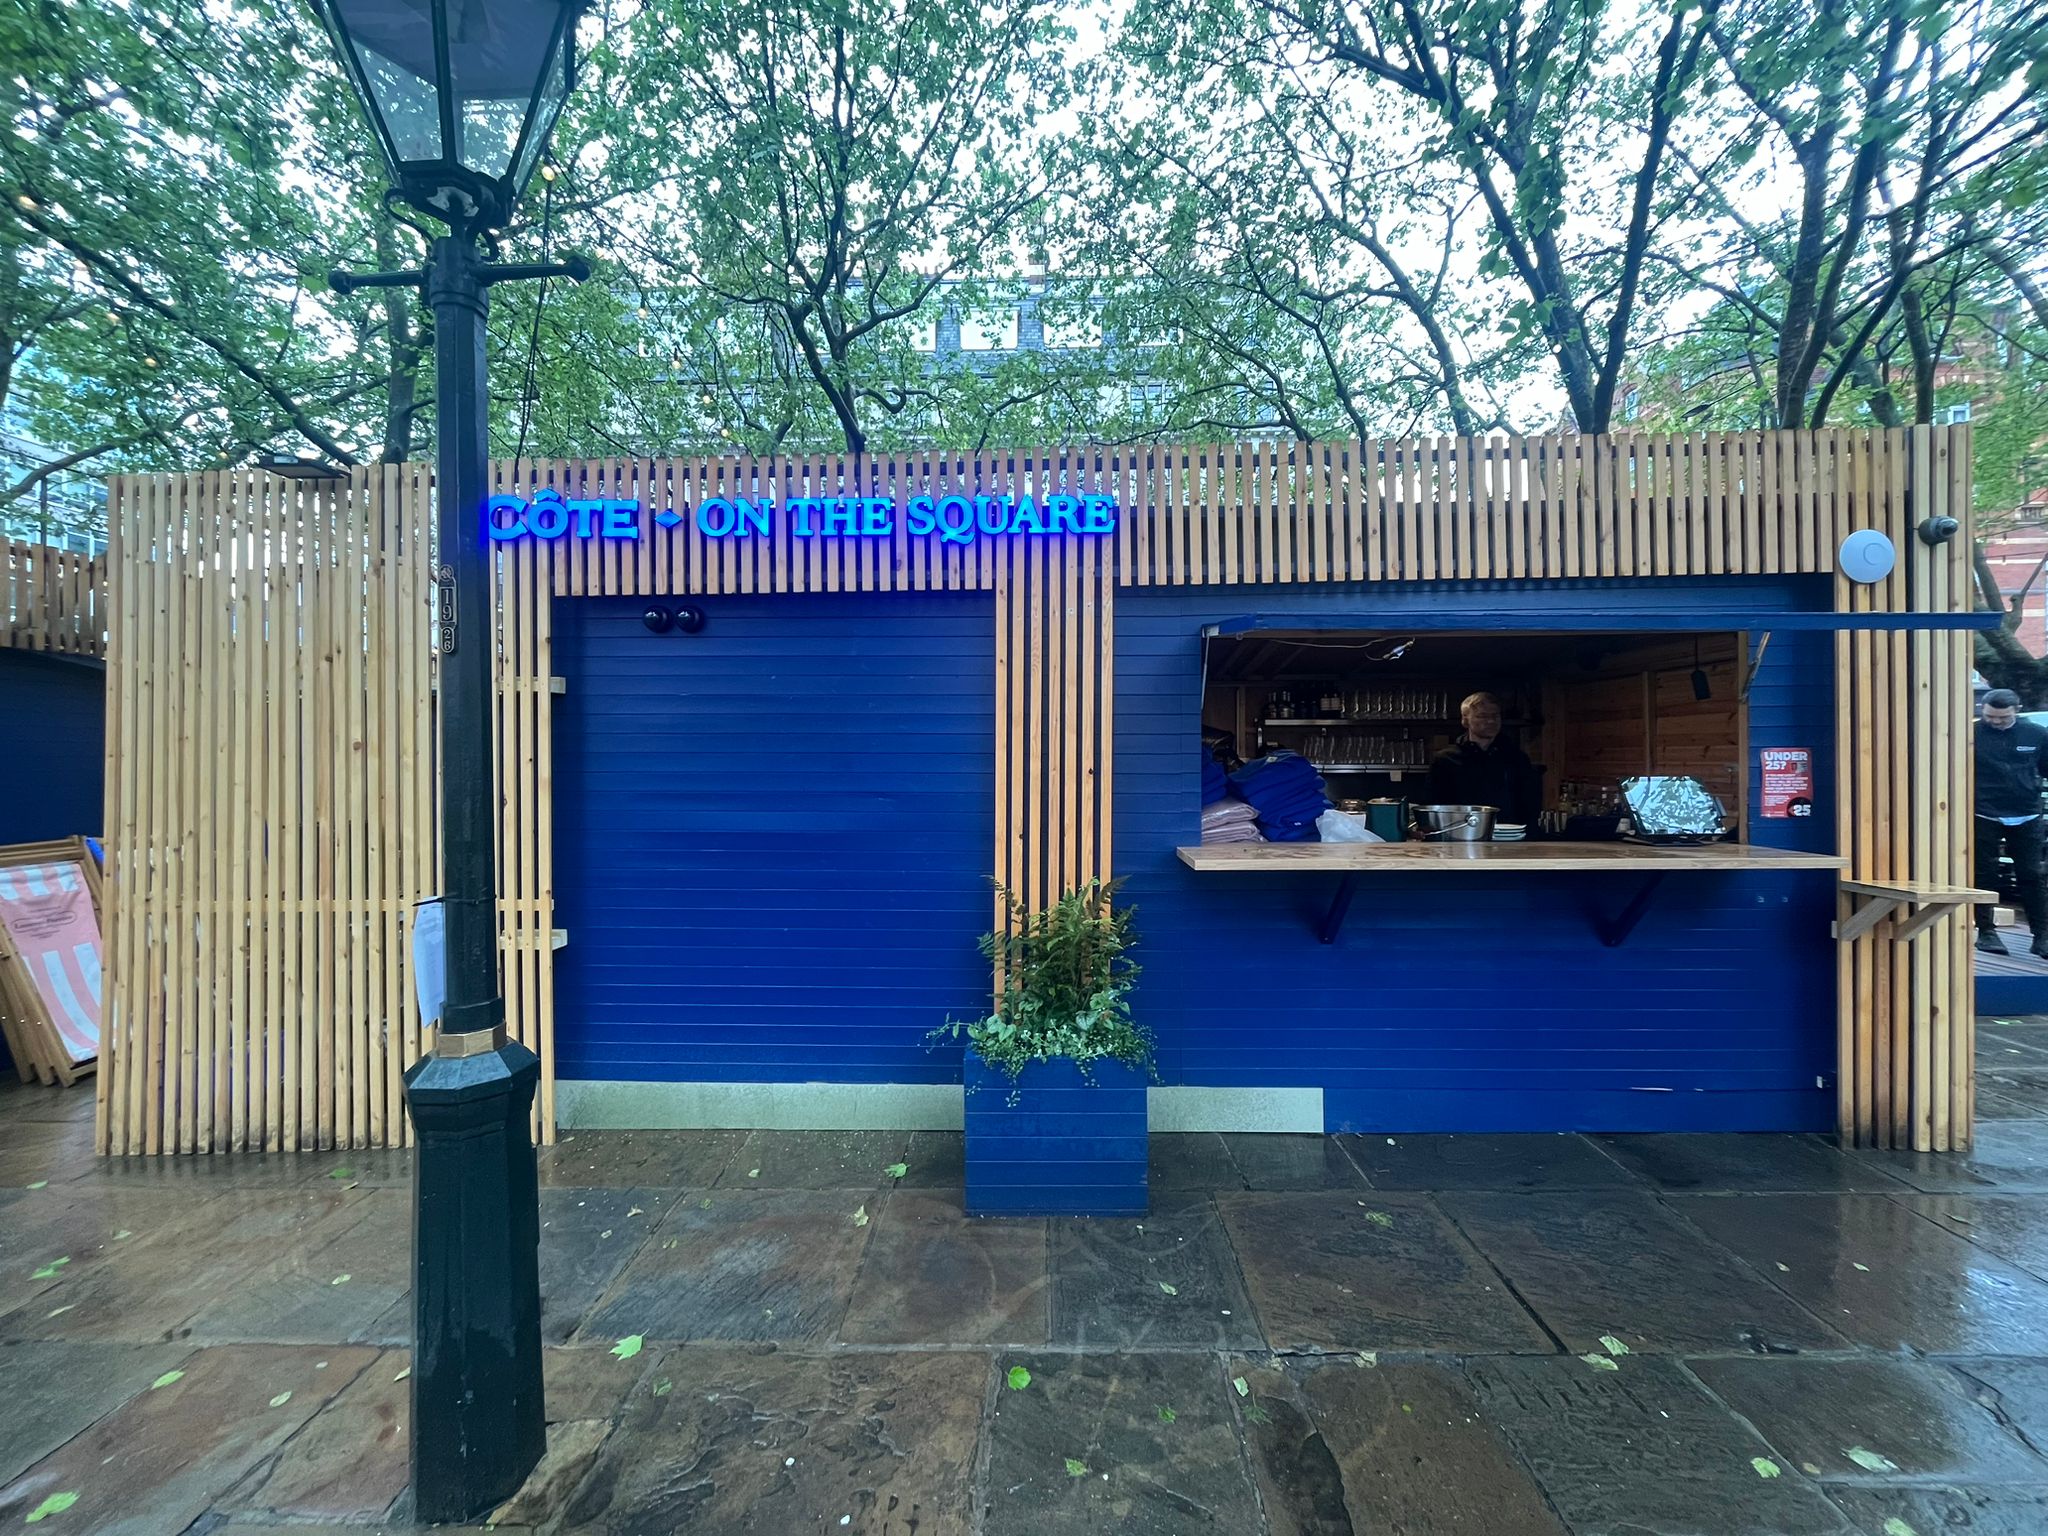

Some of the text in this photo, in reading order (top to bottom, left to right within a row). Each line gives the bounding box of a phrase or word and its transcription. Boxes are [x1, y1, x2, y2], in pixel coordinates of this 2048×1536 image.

[488, 488, 1115, 545] CÔTE ON THE SQUARE
[1764, 751, 1808, 760] UNDER
[1765, 761, 1787, 770] 25?
[1793, 804, 1811, 816] 25
